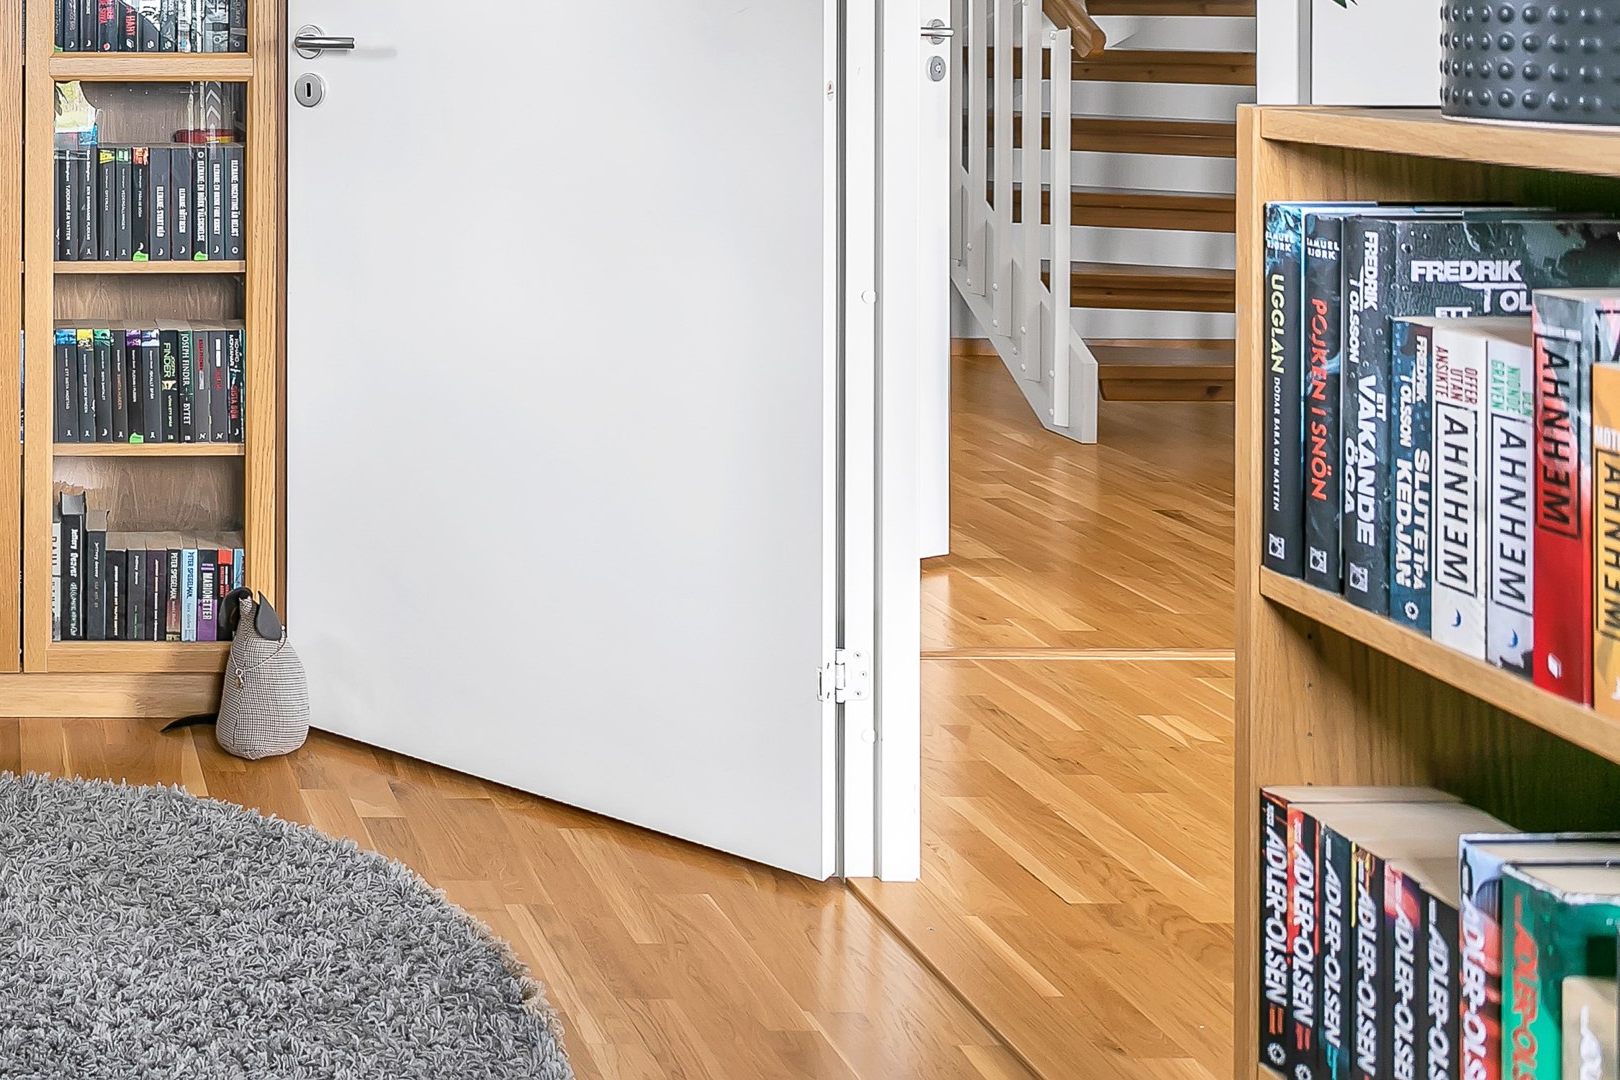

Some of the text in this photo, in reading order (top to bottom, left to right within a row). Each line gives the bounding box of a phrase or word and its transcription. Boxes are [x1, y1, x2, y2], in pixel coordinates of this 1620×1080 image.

[234, 9, 242, 25] MAY
[1364, 230, 1379, 312] FREDRIK
[1410, 259, 1523, 283] FREDRIK
[1271, 274, 1285, 374] UGGLAN
[1348, 267, 1364, 364] TOLSSON
[163, 343, 171, 378] FINDER
[181, 333, 192, 386] JOSEPH FINDER
[1415, 334, 1428, 403] FREDRIK
[1435, 345, 1449, 399] ANSIKTE
[1450, 368, 1463, 402] UTAN
[1464, 367, 1478, 404] OFFER
[1491, 359, 1505, 409] GRAVEN
[1507, 365, 1521, 414] NIONDE
[183, 403, 191, 425] BYTET
[1310, 298, 1332, 500] POJKEN I SNÖN
[1376, 393, 1386, 421] ETT
[1399, 361, 1416, 447] TOLSSON
[1273, 448, 1280, 466] OM
[1344, 436, 1359, 514] ÖGA
[1356, 374, 1377, 547] VAKANDE
[1395, 458, 1414, 588] KEDJAN
[1414, 448, 1431, 572] SLUTET
[170, 552, 178, 568] PETER
[187, 551, 195, 567] PETER
[202, 572, 213, 620] MARIONETTER
[1265, 825, 1288, 1008] ADLER-OLSEN
[1292, 842, 1314, 1028] ADLER-OLSEN
[1323, 858, 1342, 1049] ADLER-OLSEN
[1356, 882, 1377, 1078] ADLER-OLSEN
[1462, 893, 1487, 1080] ADLER-OLS
[1394, 902, 1414, 1080] ADLER-OLSE
[1428, 922, 1450, 1080] ADLER-OLS
